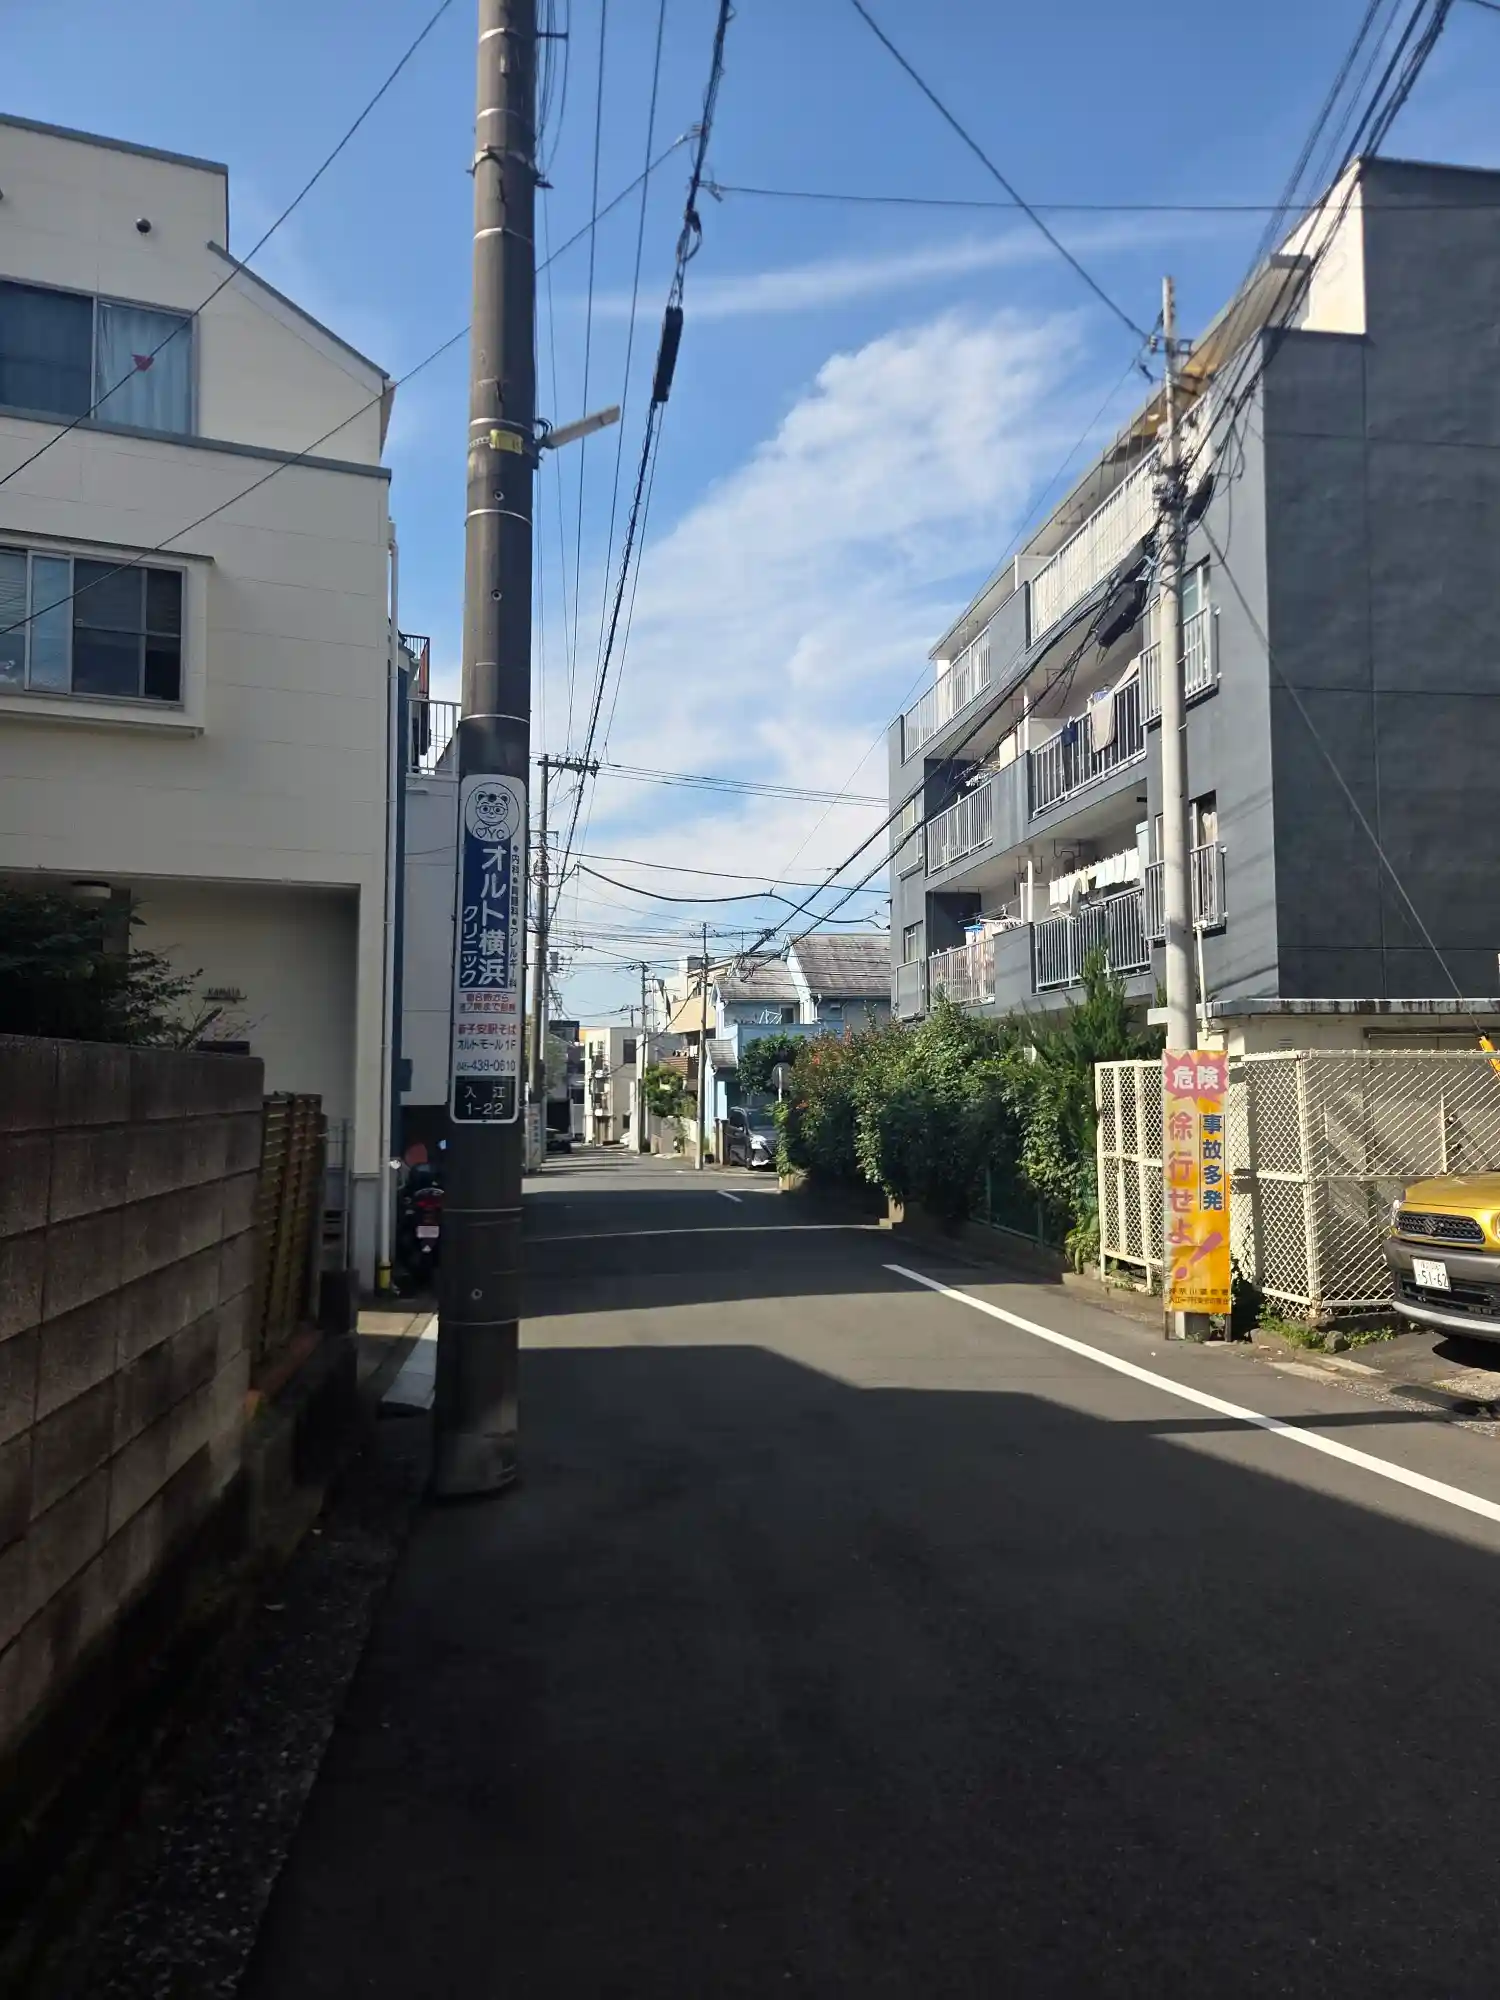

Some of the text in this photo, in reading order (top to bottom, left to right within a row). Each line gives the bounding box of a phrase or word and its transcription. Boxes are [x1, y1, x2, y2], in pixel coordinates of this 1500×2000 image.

[461, 905, 478, 987] クリニック
[478, 845, 507, 986] オルト横浜
[465, 1102, 504, 1115] 1-22
[1172, 1065, 1220, 1090] 危険
[1168, 1112, 1194, 1244] 徐行せよ
[1203, 1113, 1223, 1211] 事故多発
